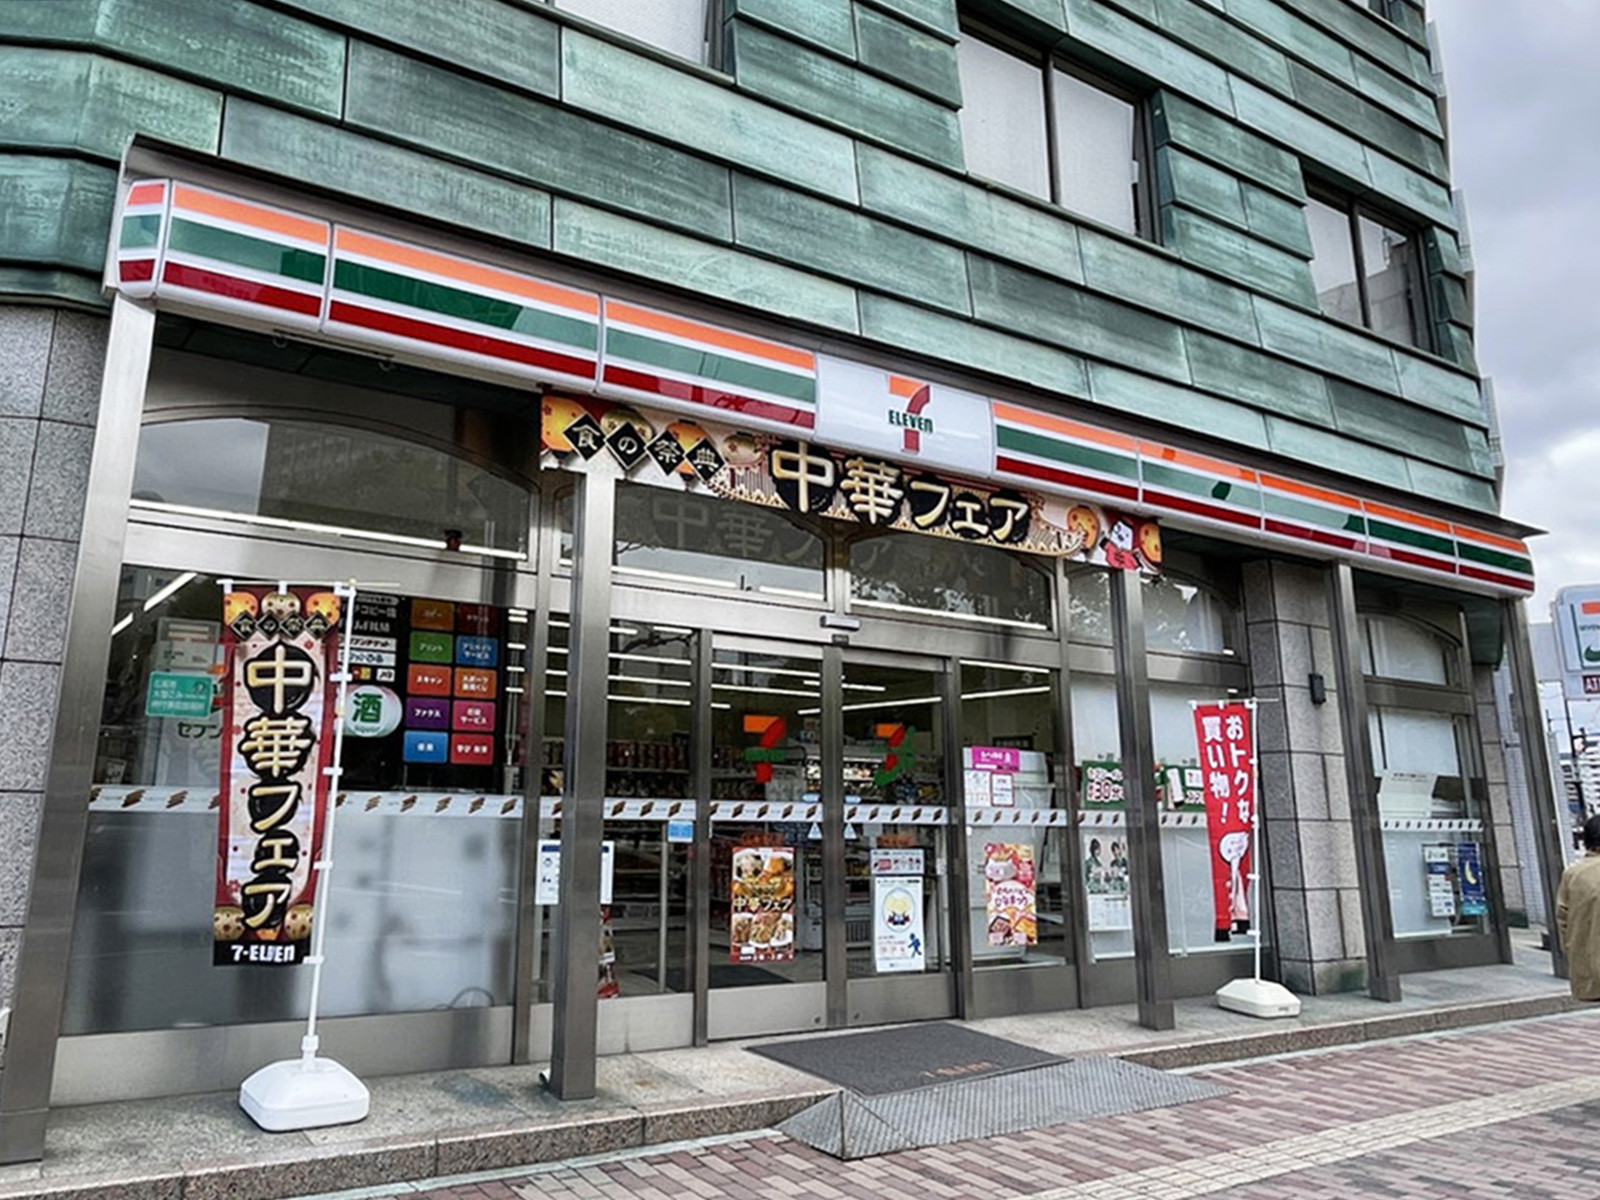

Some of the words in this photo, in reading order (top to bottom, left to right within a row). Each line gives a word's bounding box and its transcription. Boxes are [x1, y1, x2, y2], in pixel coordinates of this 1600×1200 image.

[571, 424, 720, 471] 食の祭典
[771, 438, 1029, 540] 中華フェア
[352, 692, 383, 723] 酒
[240, 643, 315, 930] 中華フェア
[1202, 716, 1230, 823] 買い物！
[1226, 715, 1249, 823] おトクな
